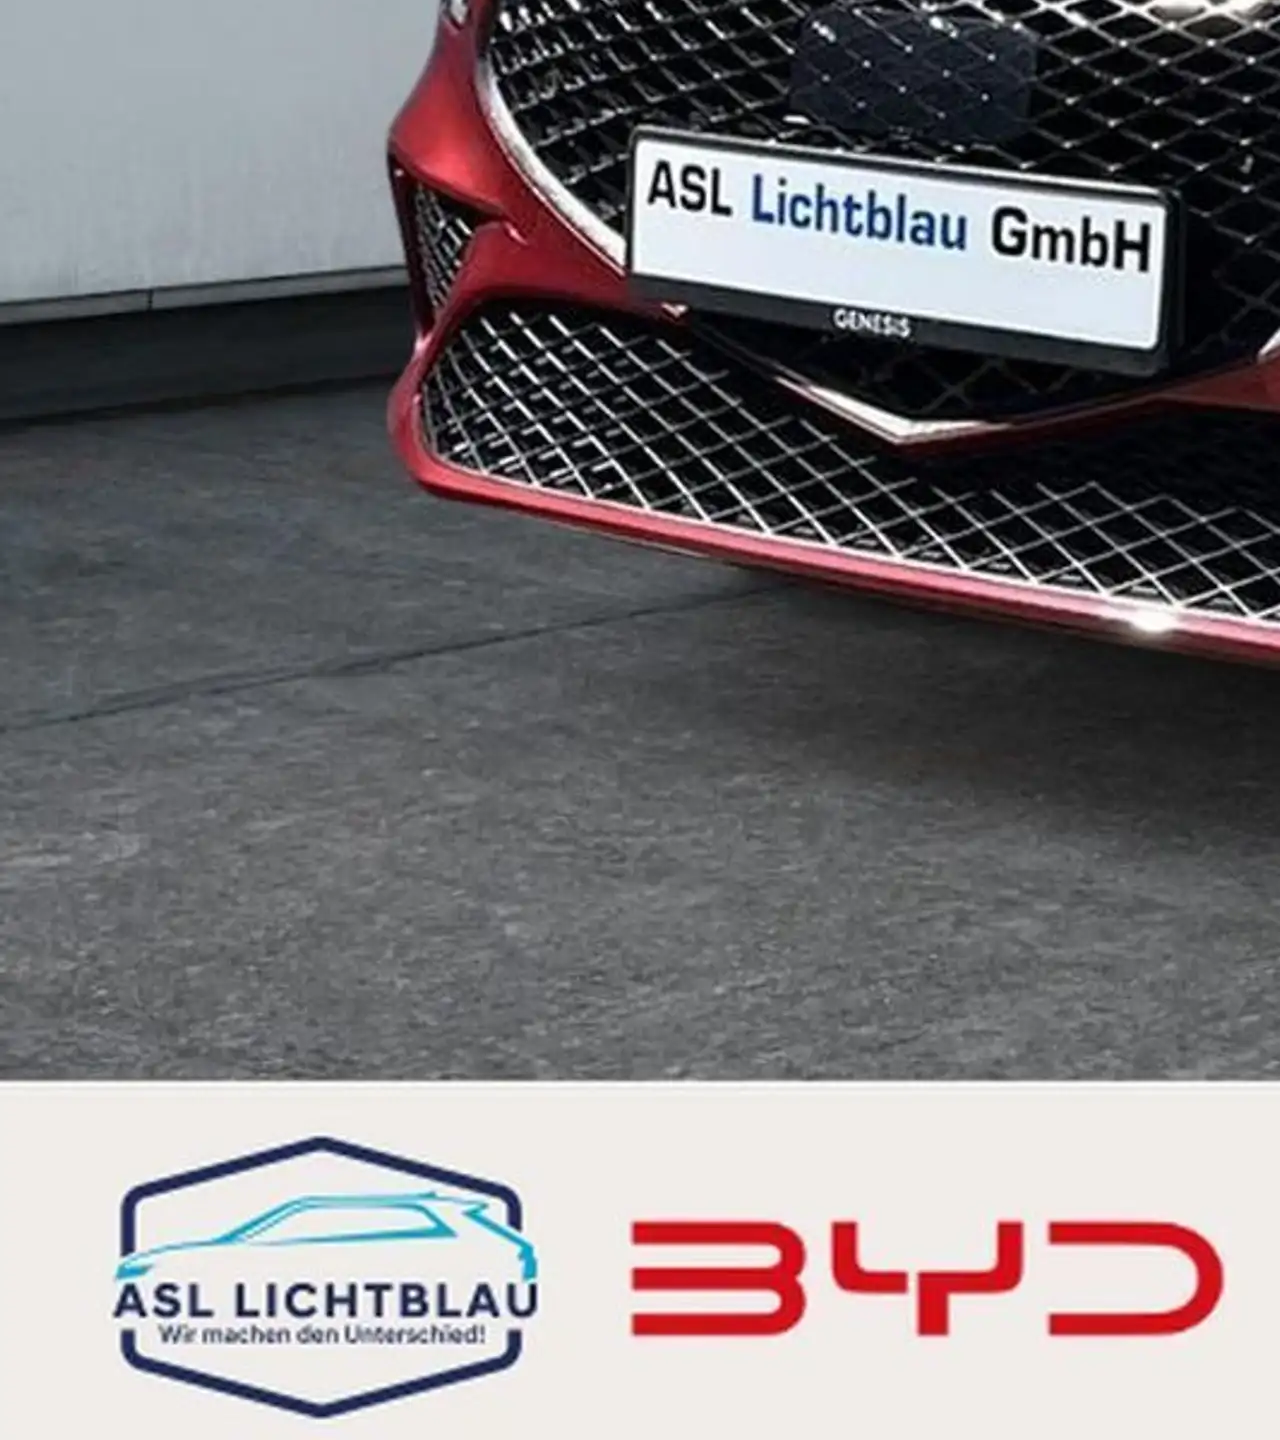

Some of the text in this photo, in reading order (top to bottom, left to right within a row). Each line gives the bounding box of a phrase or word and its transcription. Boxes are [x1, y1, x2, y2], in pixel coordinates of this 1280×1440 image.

[647, 160, 1151, 273] ASL Lichtblau GmbH
[833, 306, 912, 338] GENESIS
